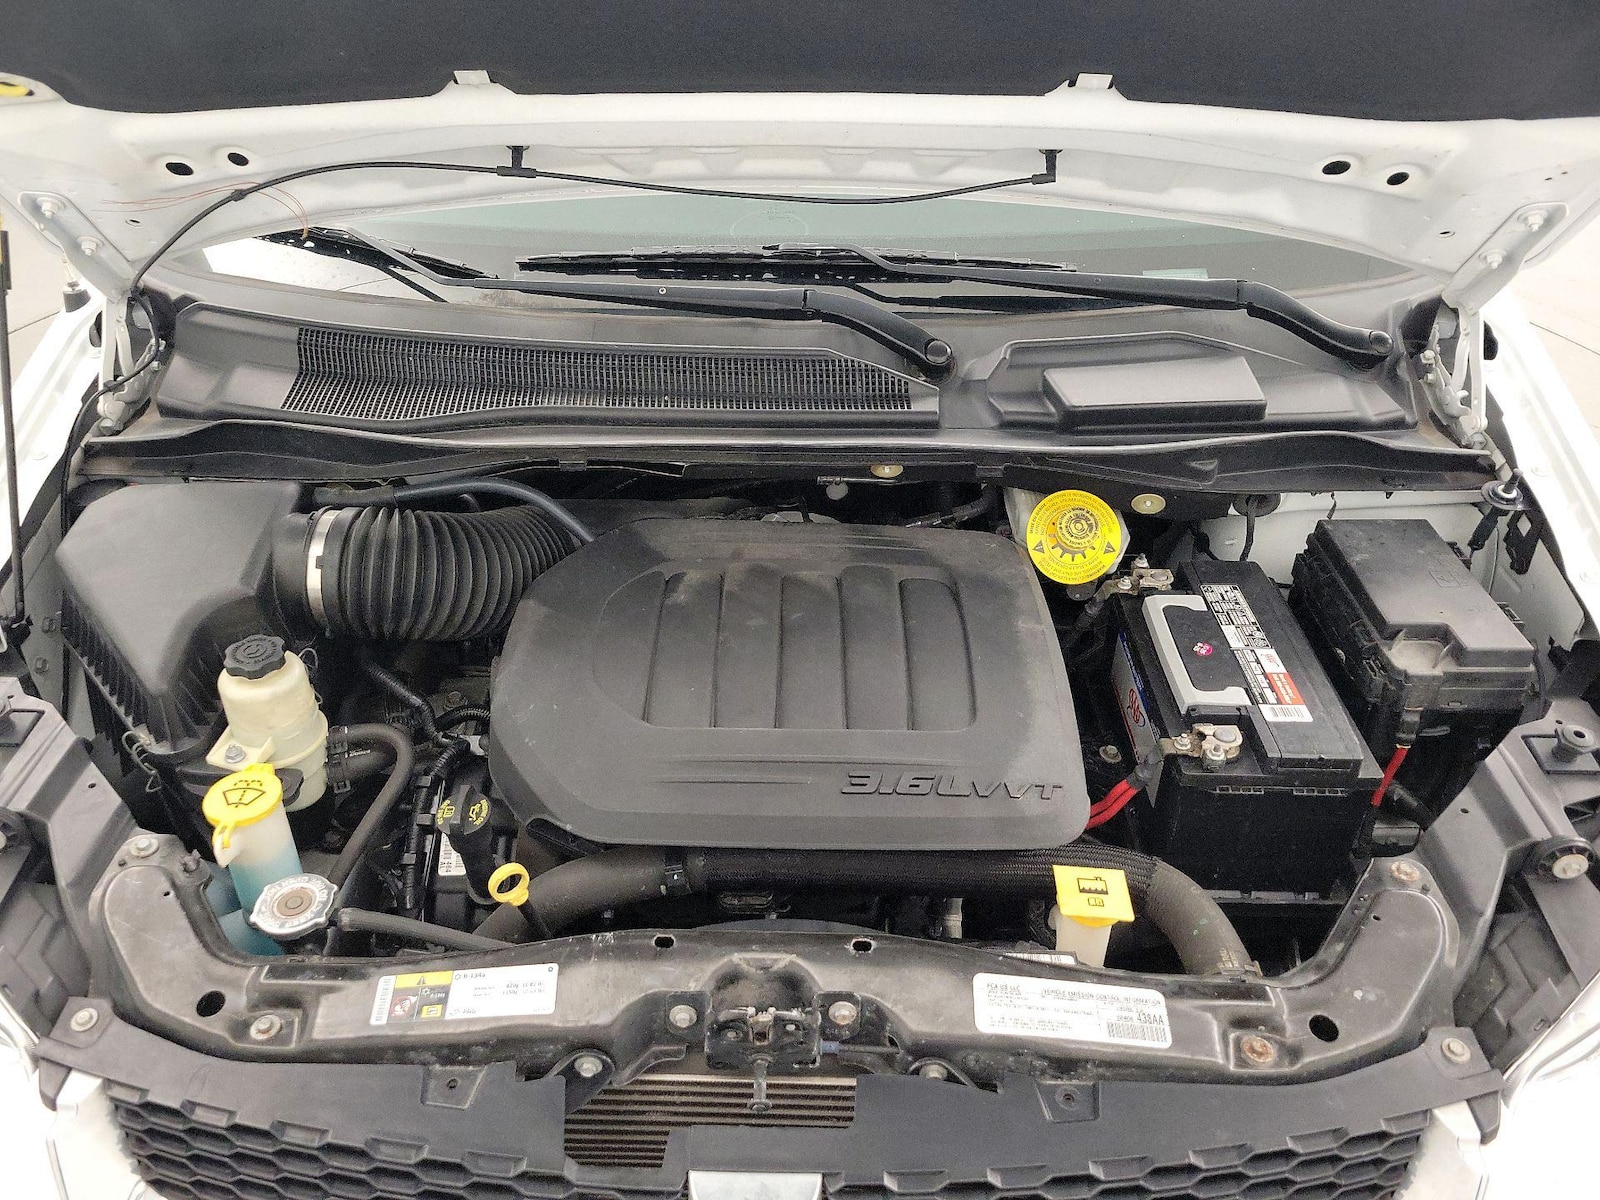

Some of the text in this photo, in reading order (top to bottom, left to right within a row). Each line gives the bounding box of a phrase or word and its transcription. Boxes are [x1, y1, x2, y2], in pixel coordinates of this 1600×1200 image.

[841, 771, 1063, 800] 3.6L VVT
[1137, 1013, 1164, 1025] 438AA
